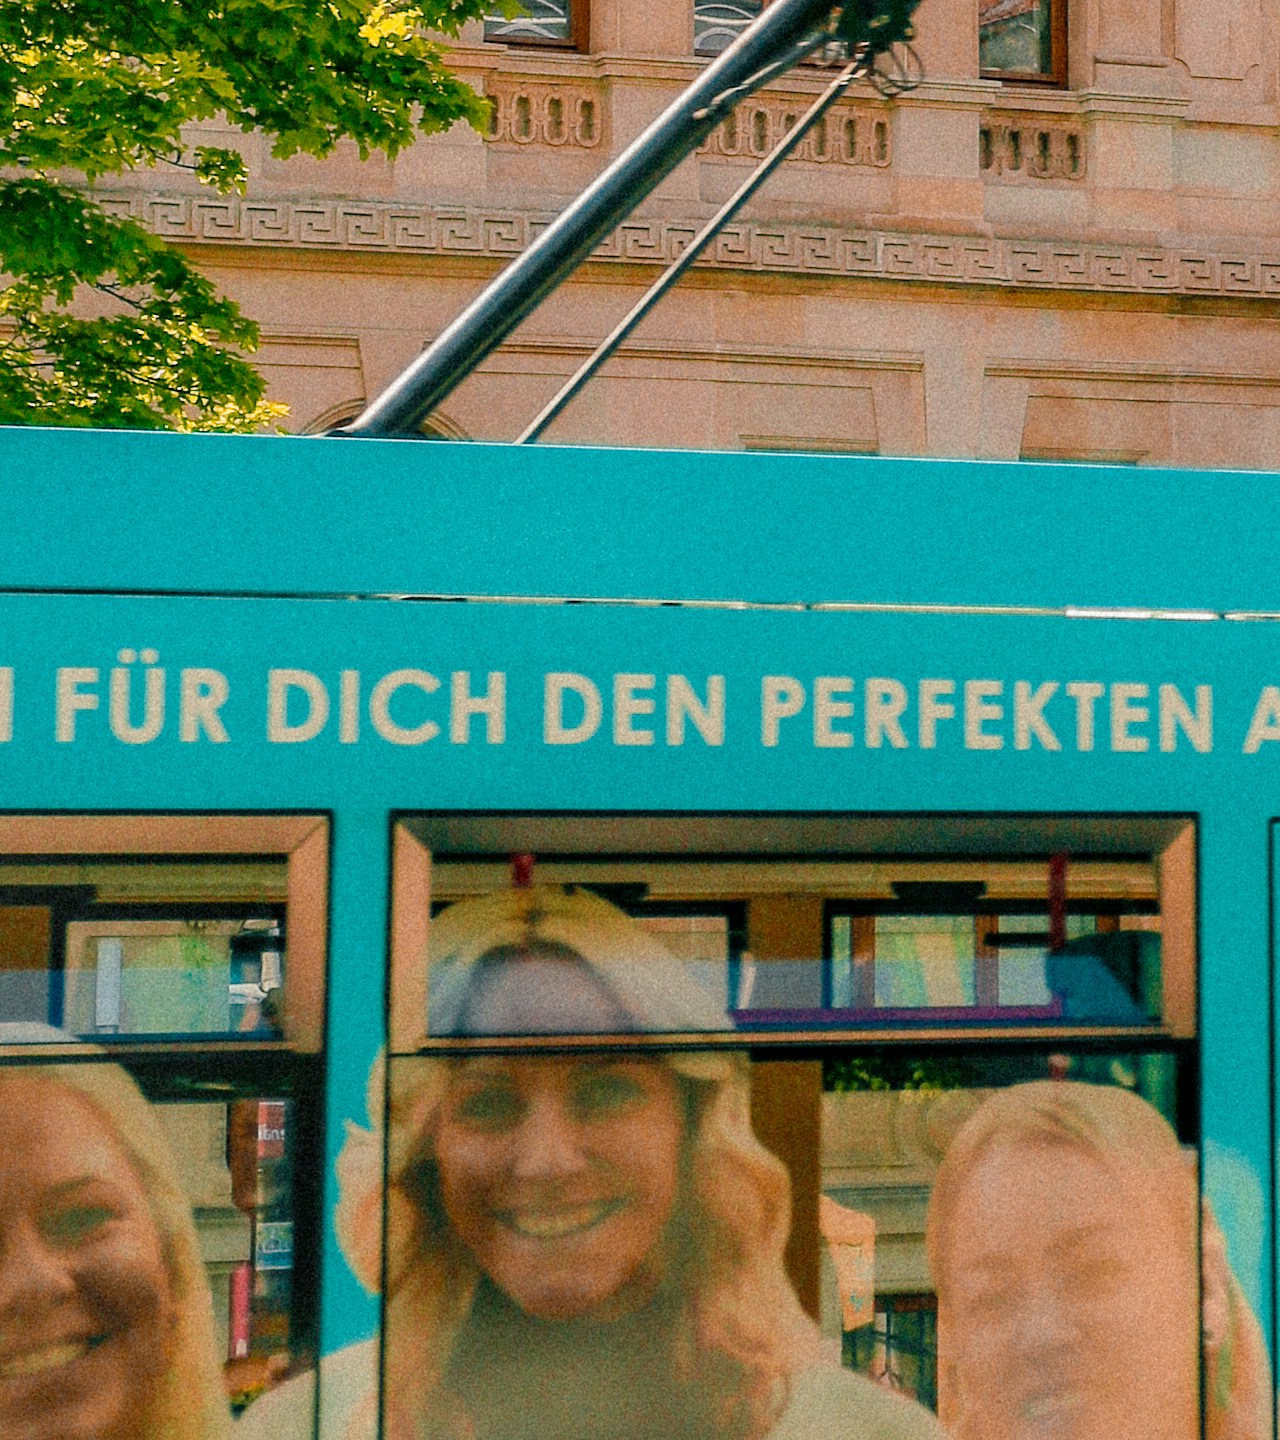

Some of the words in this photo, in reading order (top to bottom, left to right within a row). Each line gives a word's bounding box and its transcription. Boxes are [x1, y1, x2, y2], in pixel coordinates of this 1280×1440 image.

[56, 648, 229, 744] FÜR
[267, 668, 506, 745] DICH
[544, 672, 725, 746] DEN
[761, 675, 1212, 753] PERFEKTEN
